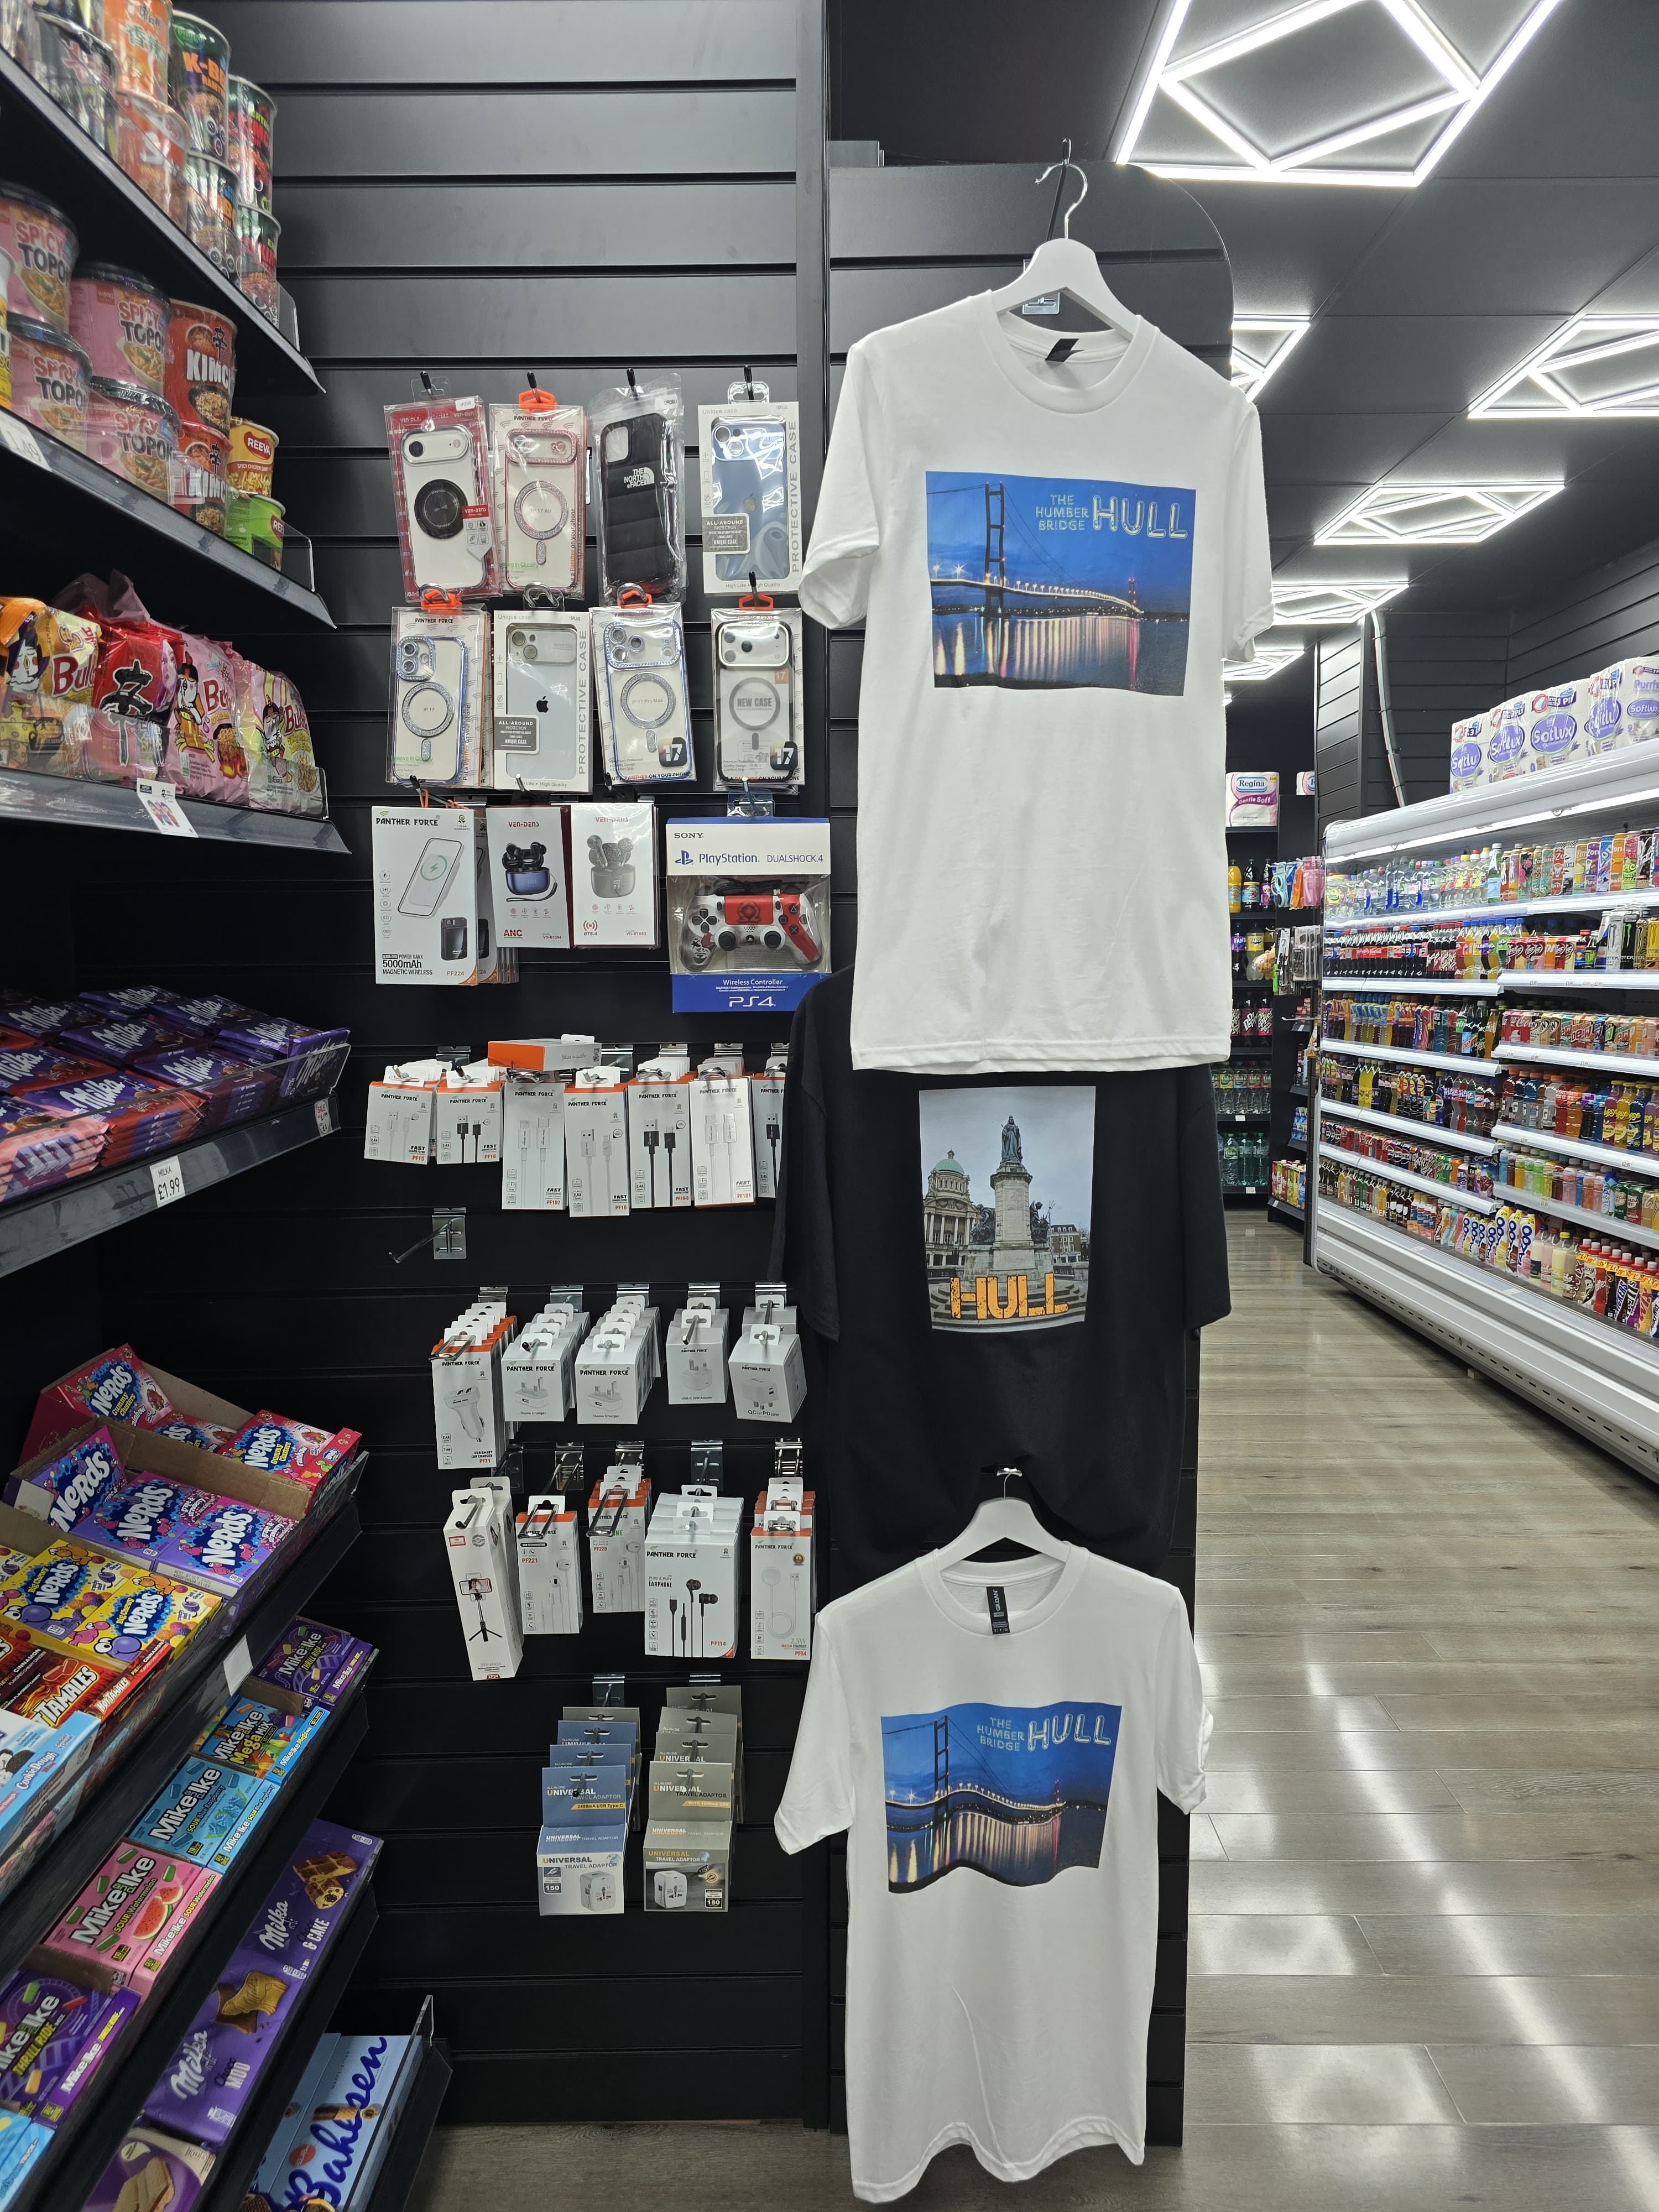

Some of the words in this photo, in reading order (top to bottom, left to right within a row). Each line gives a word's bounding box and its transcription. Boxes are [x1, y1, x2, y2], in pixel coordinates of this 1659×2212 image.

[14, 222, 64, 253] SPICY
[17, 243, 68, 284] TOPO
[117, 301, 160, 328] SPICY
[35, 376, 87, 413] TOPO
[247, 437, 270, 455] REEVA
[789, 421, 797, 465] CASE
[1035, 506, 1089, 518] HUMBER
[1050, 494, 1074, 505] THE
[273, 520, 284, 532] REE
[1039, 520, 1086, 531] BRIDGE
[1092, 495, 1188, 539] HULL
[737, 697, 752, 707] NEW
[753, 697, 772, 707] CASE
[578, 680, 587, 775] PROTECTIVE
[1533, 722, 1574, 745] Softlux
[699, 853, 758, 866] PlayStation
[177, 999, 222, 1020] Milka
[729, 996, 775, 1008] PS4
[8, 1005, 69, 1029] Milka
[92, 1022, 148, 1050] Milka
[163, 1056, 214, 1082] Milka
[60, 1079, 126, 1109] Milka
[158, 1177, 180, 1201] £1.99
[950, 1272, 1068, 1320] HULL
[112, 1392, 128, 1416] Gummy
[119, 1394, 136, 1416] Clusters
[270, 1443, 284, 1464] Gummy
[279, 1442, 291, 1462] Clusters
[295, 1446, 308, 1467] rainbow
[33, 1567, 48, 1585] Chewy
[121, 1597, 135, 1616] Chewy
[13, 1648, 41, 1673] CINNAMON
[143, 1641, 165, 1663] CINNAMON
[278, 1648, 308, 1676] Mike
[301, 1654, 316, 1671] THRILL
[312, 1646, 323, 1659] RIDE
[977, 1724, 1025, 1741] HUMBER
[990, 1717, 1011, 1729] THE
[1027, 1713, 1112, 1752] HULL
[230, 1735, 263, 1765] Mega
[980, 1736, 1020, 1751] BRIDGE
[150, 1796, 197, 1840] Mike
[189, 1769, 222, 1794] Ike
[187, 1818, 201, 1833] SOUR
[197, 1806, 209, 1819] Blue
[205, 1785, 226, 1809] Raspberry
[70, 1889, 127, 1944] Mike
[119, 1858, 156, 1897] Ike
[114, 1910, 132, 1933] SOUR
[128, 1877, 157, 1916] Watermelon
[184, 1901, 197, 1917] SOUR
[194, 1874, 217, 1906] Watermelon
[258, 1899, 289, 1951] Milka
[310, 1917, 330, 1942] CAKE
[13, 2042, 41, 2076] THRILL
[170, 2030, 208, 2100] Milka
